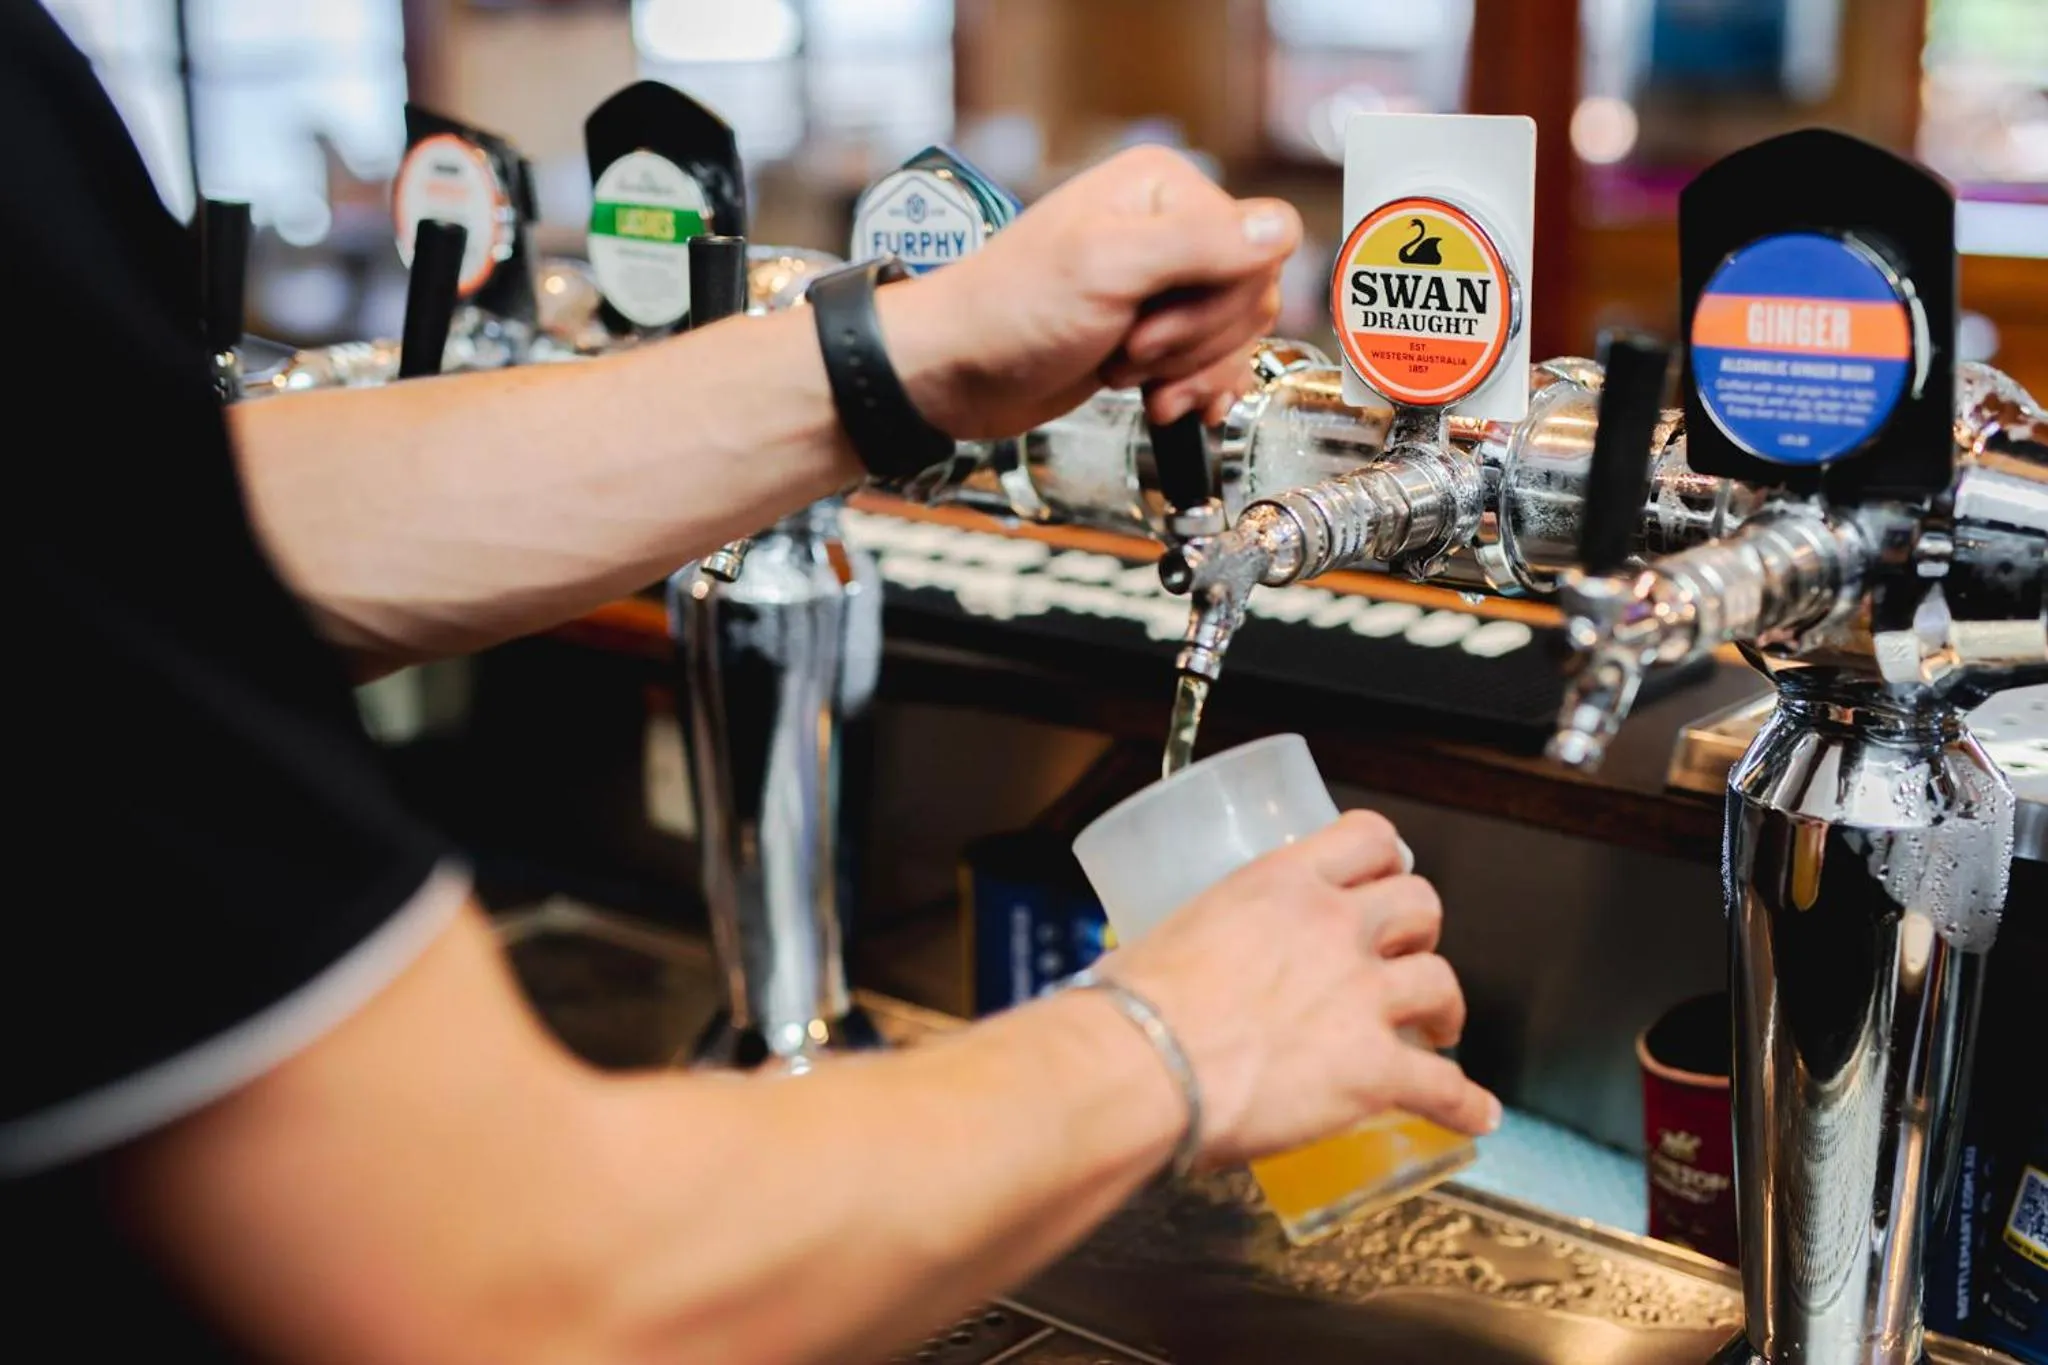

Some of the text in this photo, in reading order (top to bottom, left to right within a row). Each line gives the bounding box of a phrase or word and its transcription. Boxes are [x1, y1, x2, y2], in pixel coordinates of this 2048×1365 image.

[873, 232, 965, 257] FURPHY
[1351, 270, 1491, 314] SWAN
[1362, 311, 1478, 336] DRAUGHT
[1747, 303, 1852, 349] GINGER
[1371, 350, 1468, 366] WESTERN AUSTRALIA
[1409, 342, 1426, 352] EST
